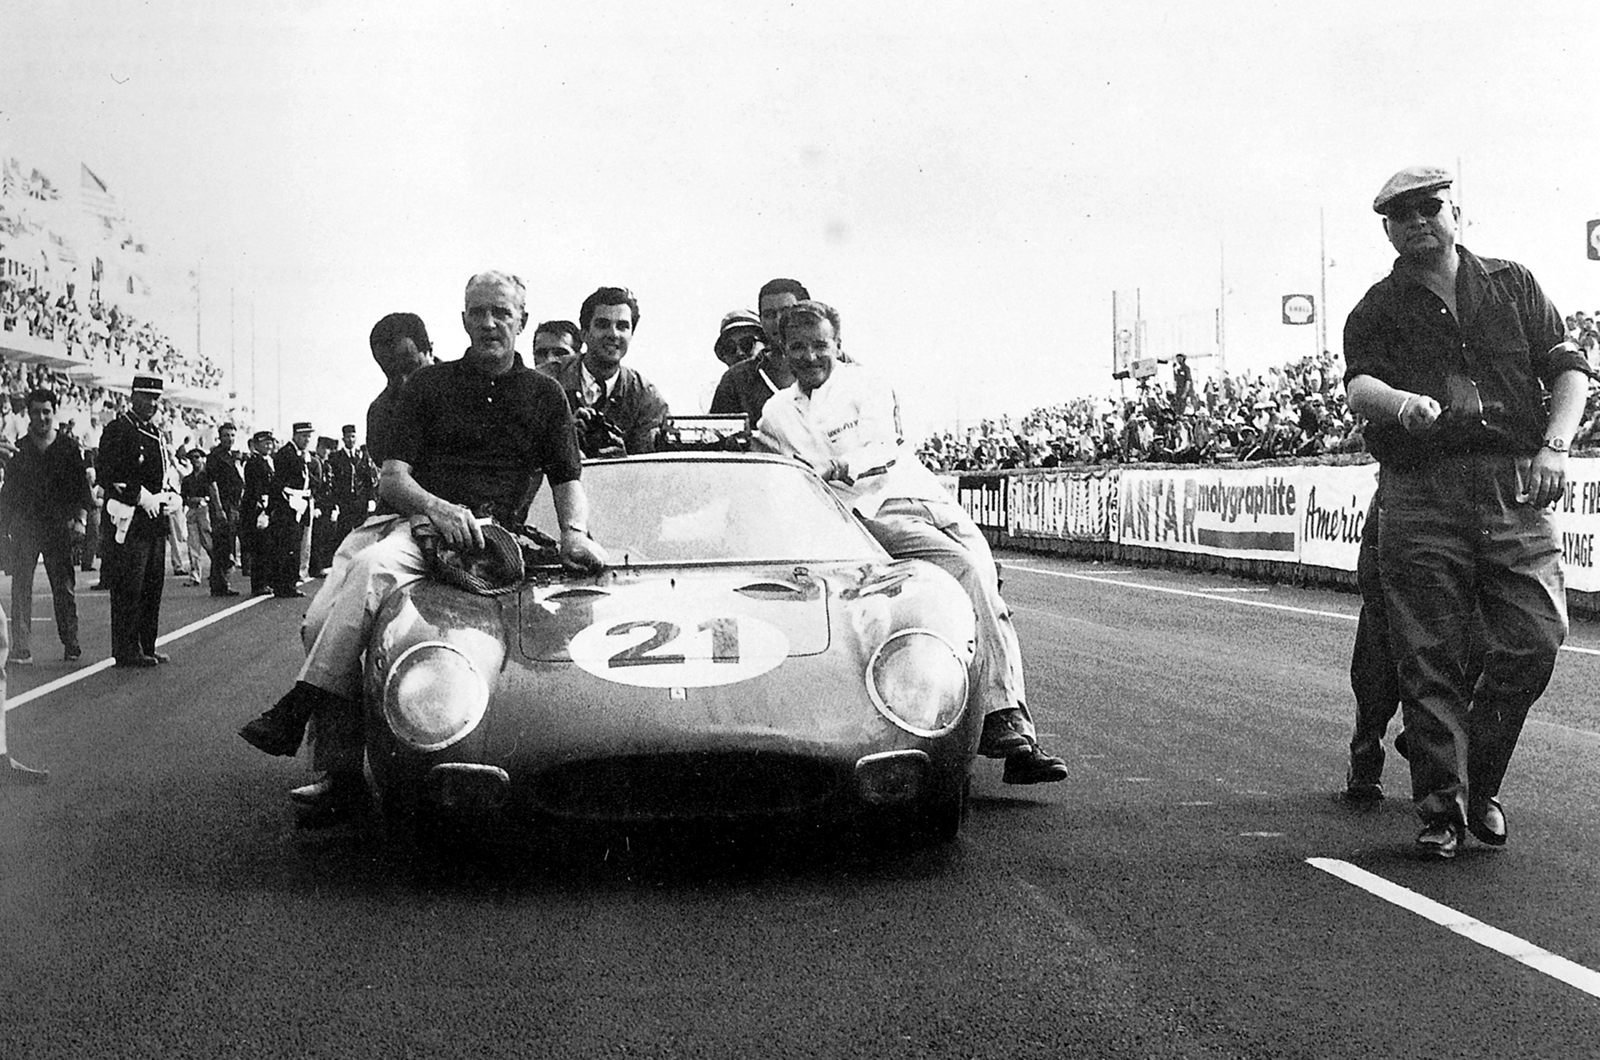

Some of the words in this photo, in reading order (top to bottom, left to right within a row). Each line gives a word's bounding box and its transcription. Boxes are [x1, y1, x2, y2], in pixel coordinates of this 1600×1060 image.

[1122, 478, 1198, 544] ANTAR
[1197, 476, 1297, 523] molygraphite
[1304, 485, 1365, 544] Americ
[605, 618, 740, 668] 21
